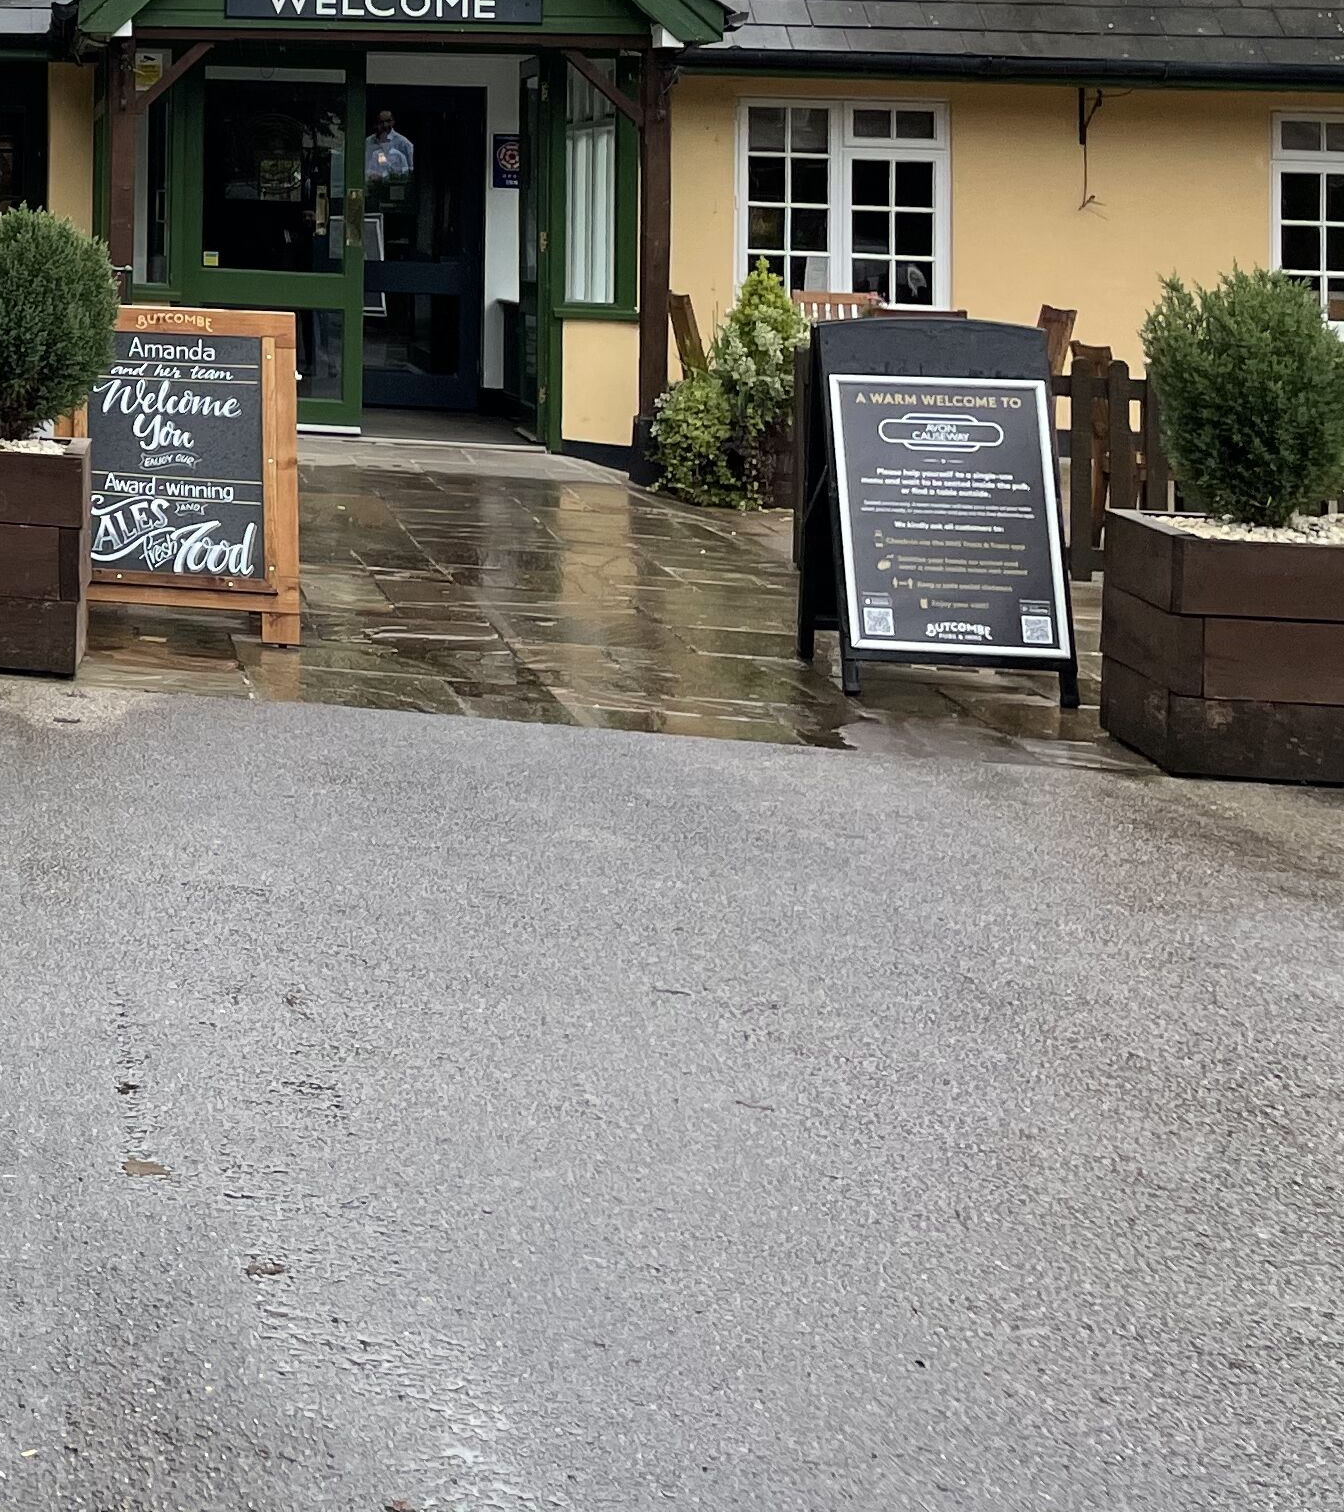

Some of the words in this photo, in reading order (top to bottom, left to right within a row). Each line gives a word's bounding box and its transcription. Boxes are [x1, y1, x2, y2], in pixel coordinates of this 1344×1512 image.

[136, 313, 213, 332] BUTCOMBE
[128, 336, 216, 361] Amanda
[111, 362, 148, 377] and
[154, 364, 181, 379] her
[190, 365, 234, 380] team
[93, 379, 242, 418] Welcome
[856, 392, 866, 404] A
[870, 392, 917, 405] WARM
[921, 394, 997, 408] WELCOME
[1000, 396, 1022, 409] TO
[132, 413, 194, 451] You
[912, 431, 970, 442] CAUSEWAY
[926, 424, 957, 433] AVON
[143, 454, 172, 467] ENJOY
[175, 453, 195, 465] OUR
[179, 501, 201, 511] AND
[92, 498, 170, 551] ALES
[139, 533, 178, 571] fresh
[170, 520, 258, 577] Food
[925, 621, 993, 640] BUTCOMBE
